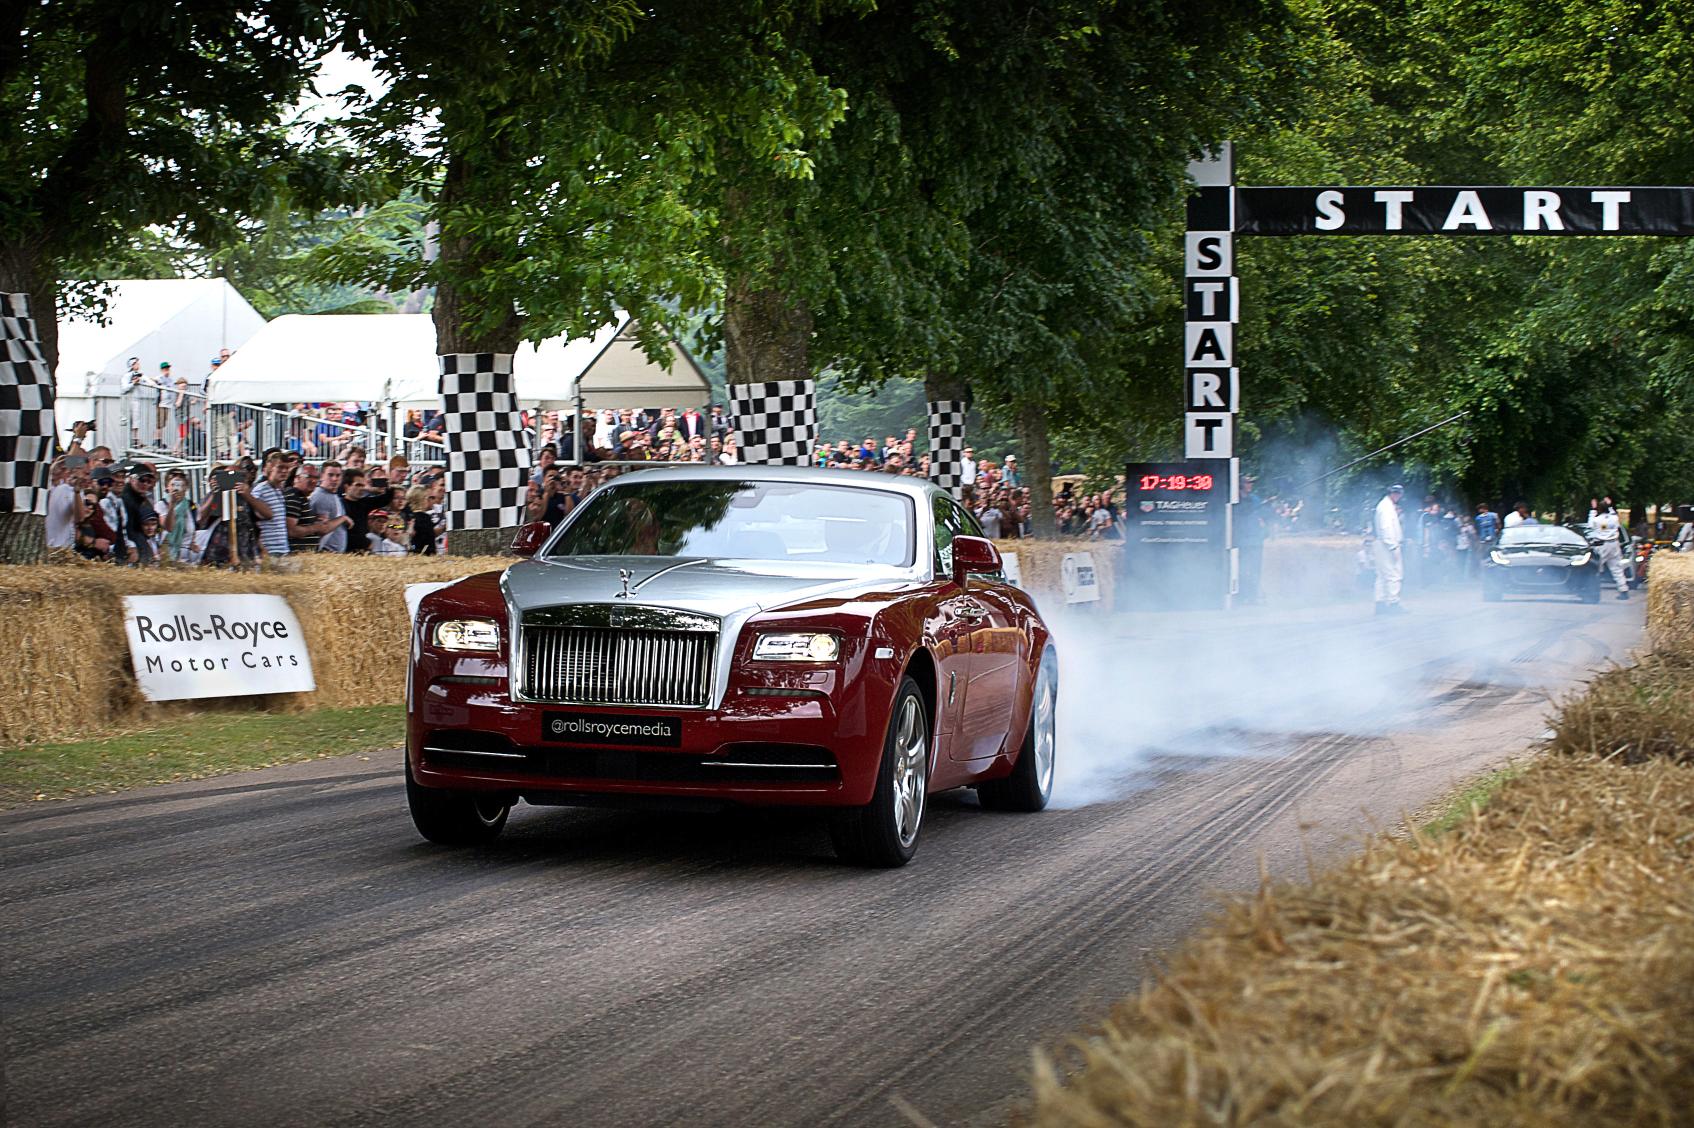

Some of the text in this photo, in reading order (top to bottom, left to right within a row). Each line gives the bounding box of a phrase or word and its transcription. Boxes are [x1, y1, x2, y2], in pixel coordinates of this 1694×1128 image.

[1314, 190, 1631, 231] START
[1192, 237, 1226, 452] START
[135, 614, 289, 647] Rolls-Royce
[145, 651, 298, 673] Motor Cars
[551, 719, 671, 737] @rollsroycemedia
